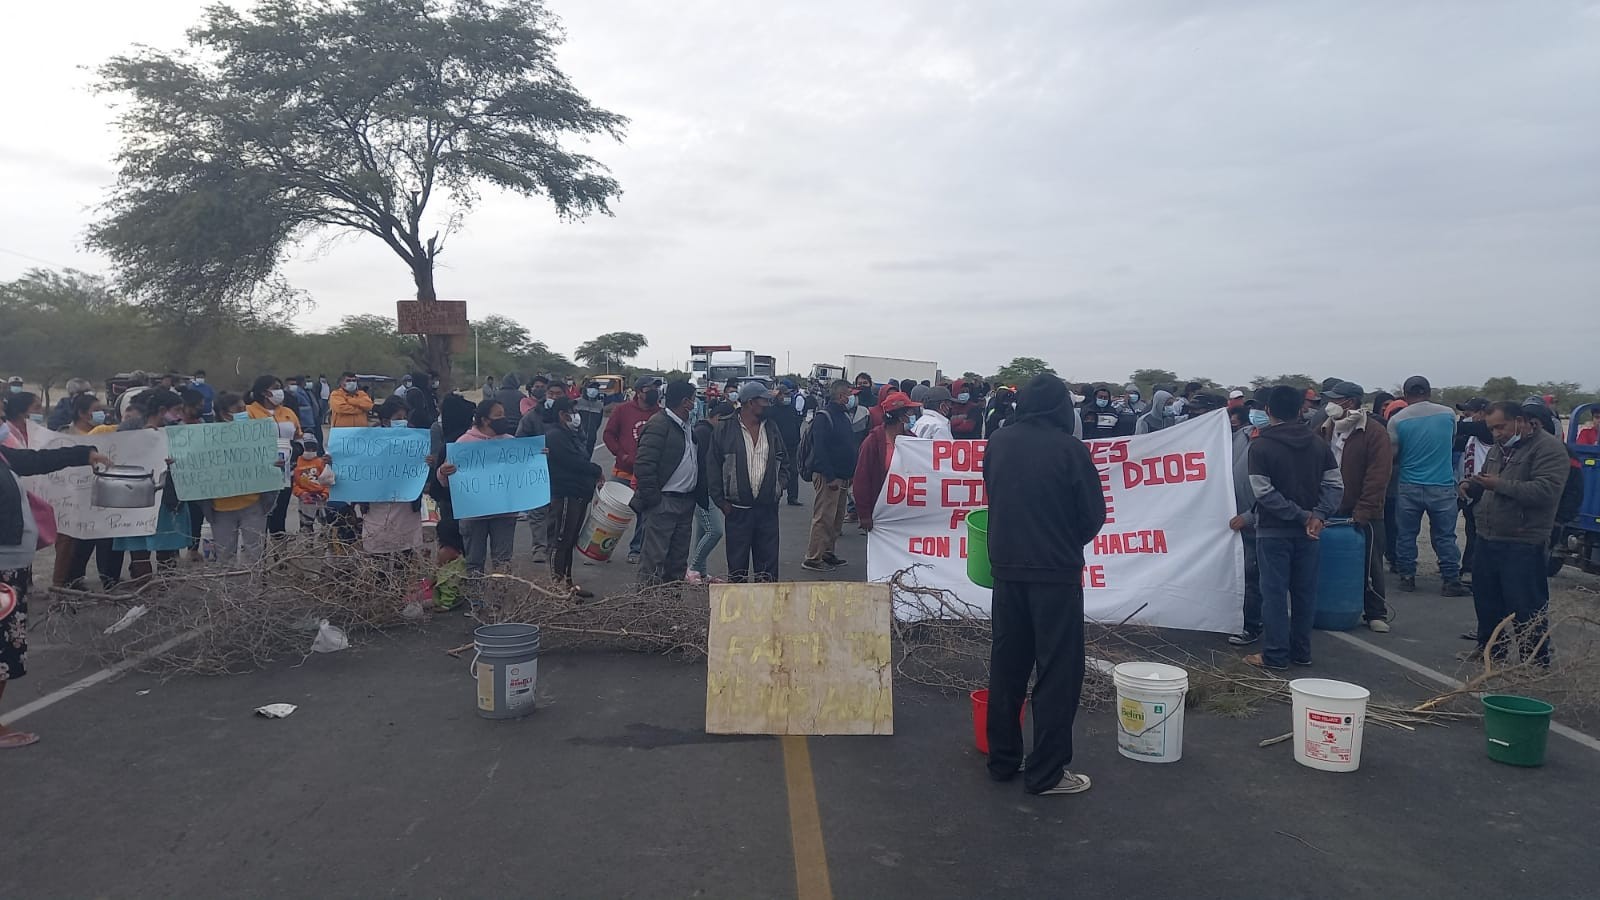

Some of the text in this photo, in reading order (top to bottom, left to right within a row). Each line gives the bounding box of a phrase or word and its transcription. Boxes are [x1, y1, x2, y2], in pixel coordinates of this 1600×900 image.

[203, 421, 277, 447] PRESIDENTE
[253, 445, 276, 464] MAS
[340, 437, 385, 458] TODOS
[497, 447, 535, 465] AGUA
[219, 468, 235, 482] EN
[238, 466, 251, 481] UN
[460, 477, 481, 495] NO
[488, 473, 511, 494] HAY
[886, 473, 927, 507] DE
[1122, 451, 1206, 489] DIOS
[909, 536, 950, 559] CON
[1093, 530, 1168, 556] HACIA
[808, 584, 866, 622] ME
